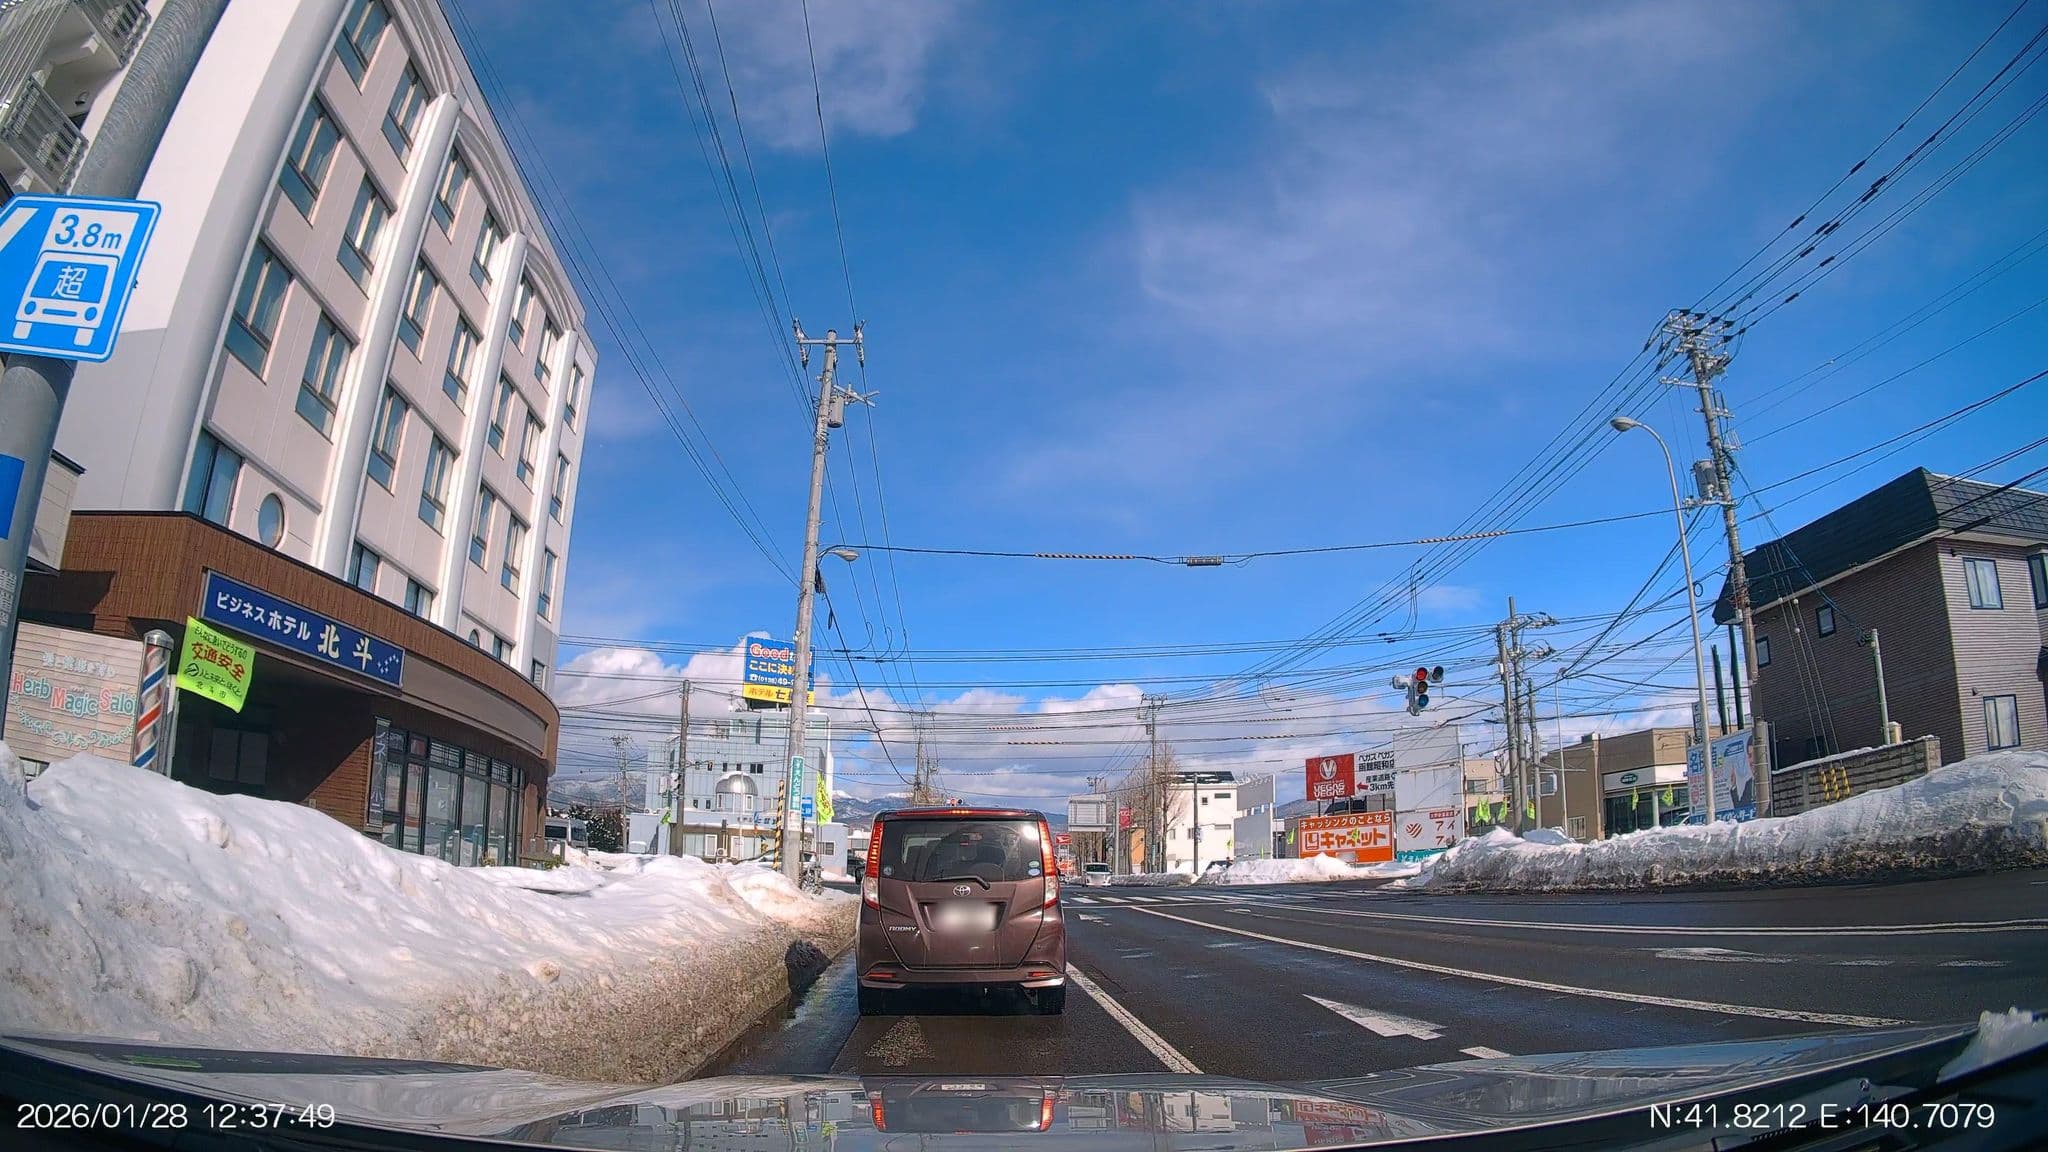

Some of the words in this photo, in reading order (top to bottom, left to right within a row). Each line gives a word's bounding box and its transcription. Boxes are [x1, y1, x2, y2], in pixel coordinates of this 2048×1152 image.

[55, 214, 122, 249] 3.8m
[51, 265, 88, 299] 超
[217, 591, 311, 642] ビジネスホテル
[317, 624, 373, 671] 北斗
[191, 641, 246, 683] 交通安全
[750, 643, 789, 662] Good
[12, 671, 51, 699] Herb
[51, 686, 99, 717] Magic
[99, 687, 135, 716] Salo
[748, 687, 773, 698] ホテル
[1314, 782, 1345, 792] VEGAS
[1301, 813, 1391, 829] キャッシングのことなら
